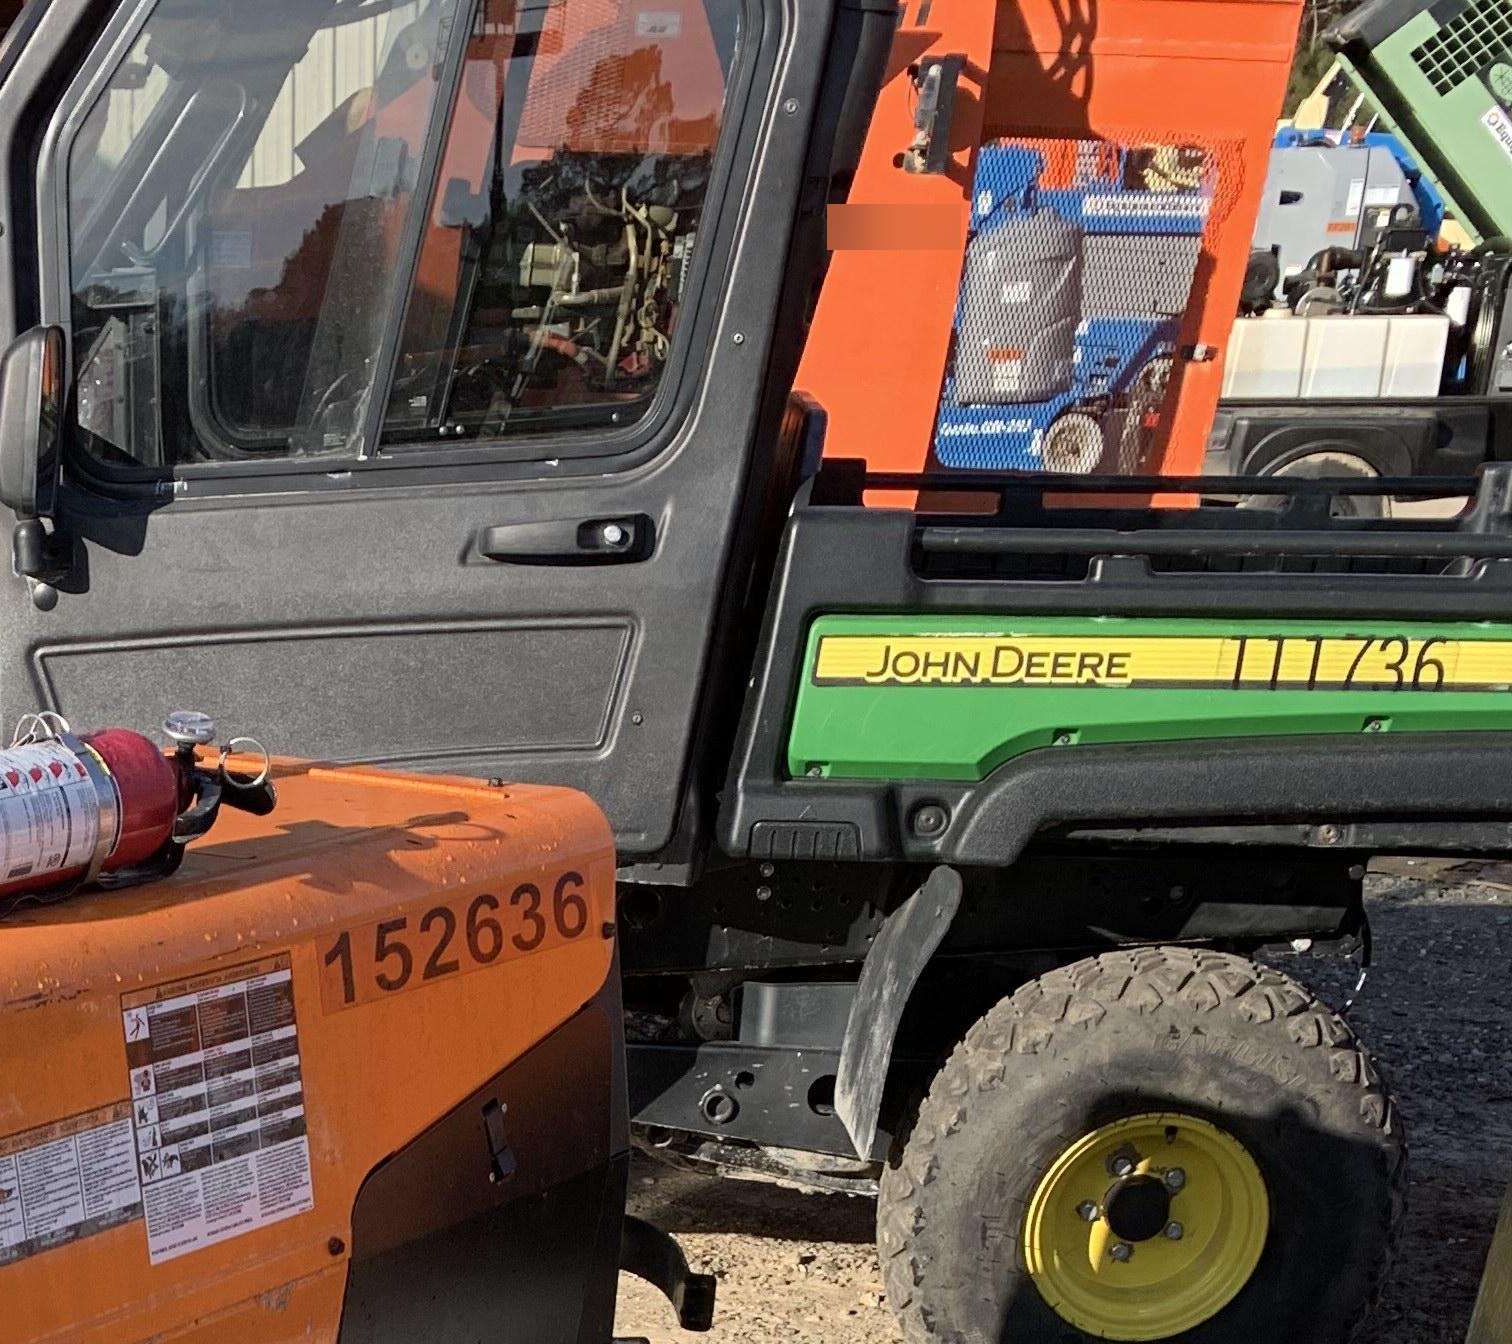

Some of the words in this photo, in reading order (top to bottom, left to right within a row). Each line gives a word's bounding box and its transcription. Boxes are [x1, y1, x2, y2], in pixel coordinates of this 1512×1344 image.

[866, 645, 980, 679] JOHN
[990, 646, 1132, 680] DEERE
[1230, 635, 1449, 692] 111736
[324, 871, 588, 1004] 152636
